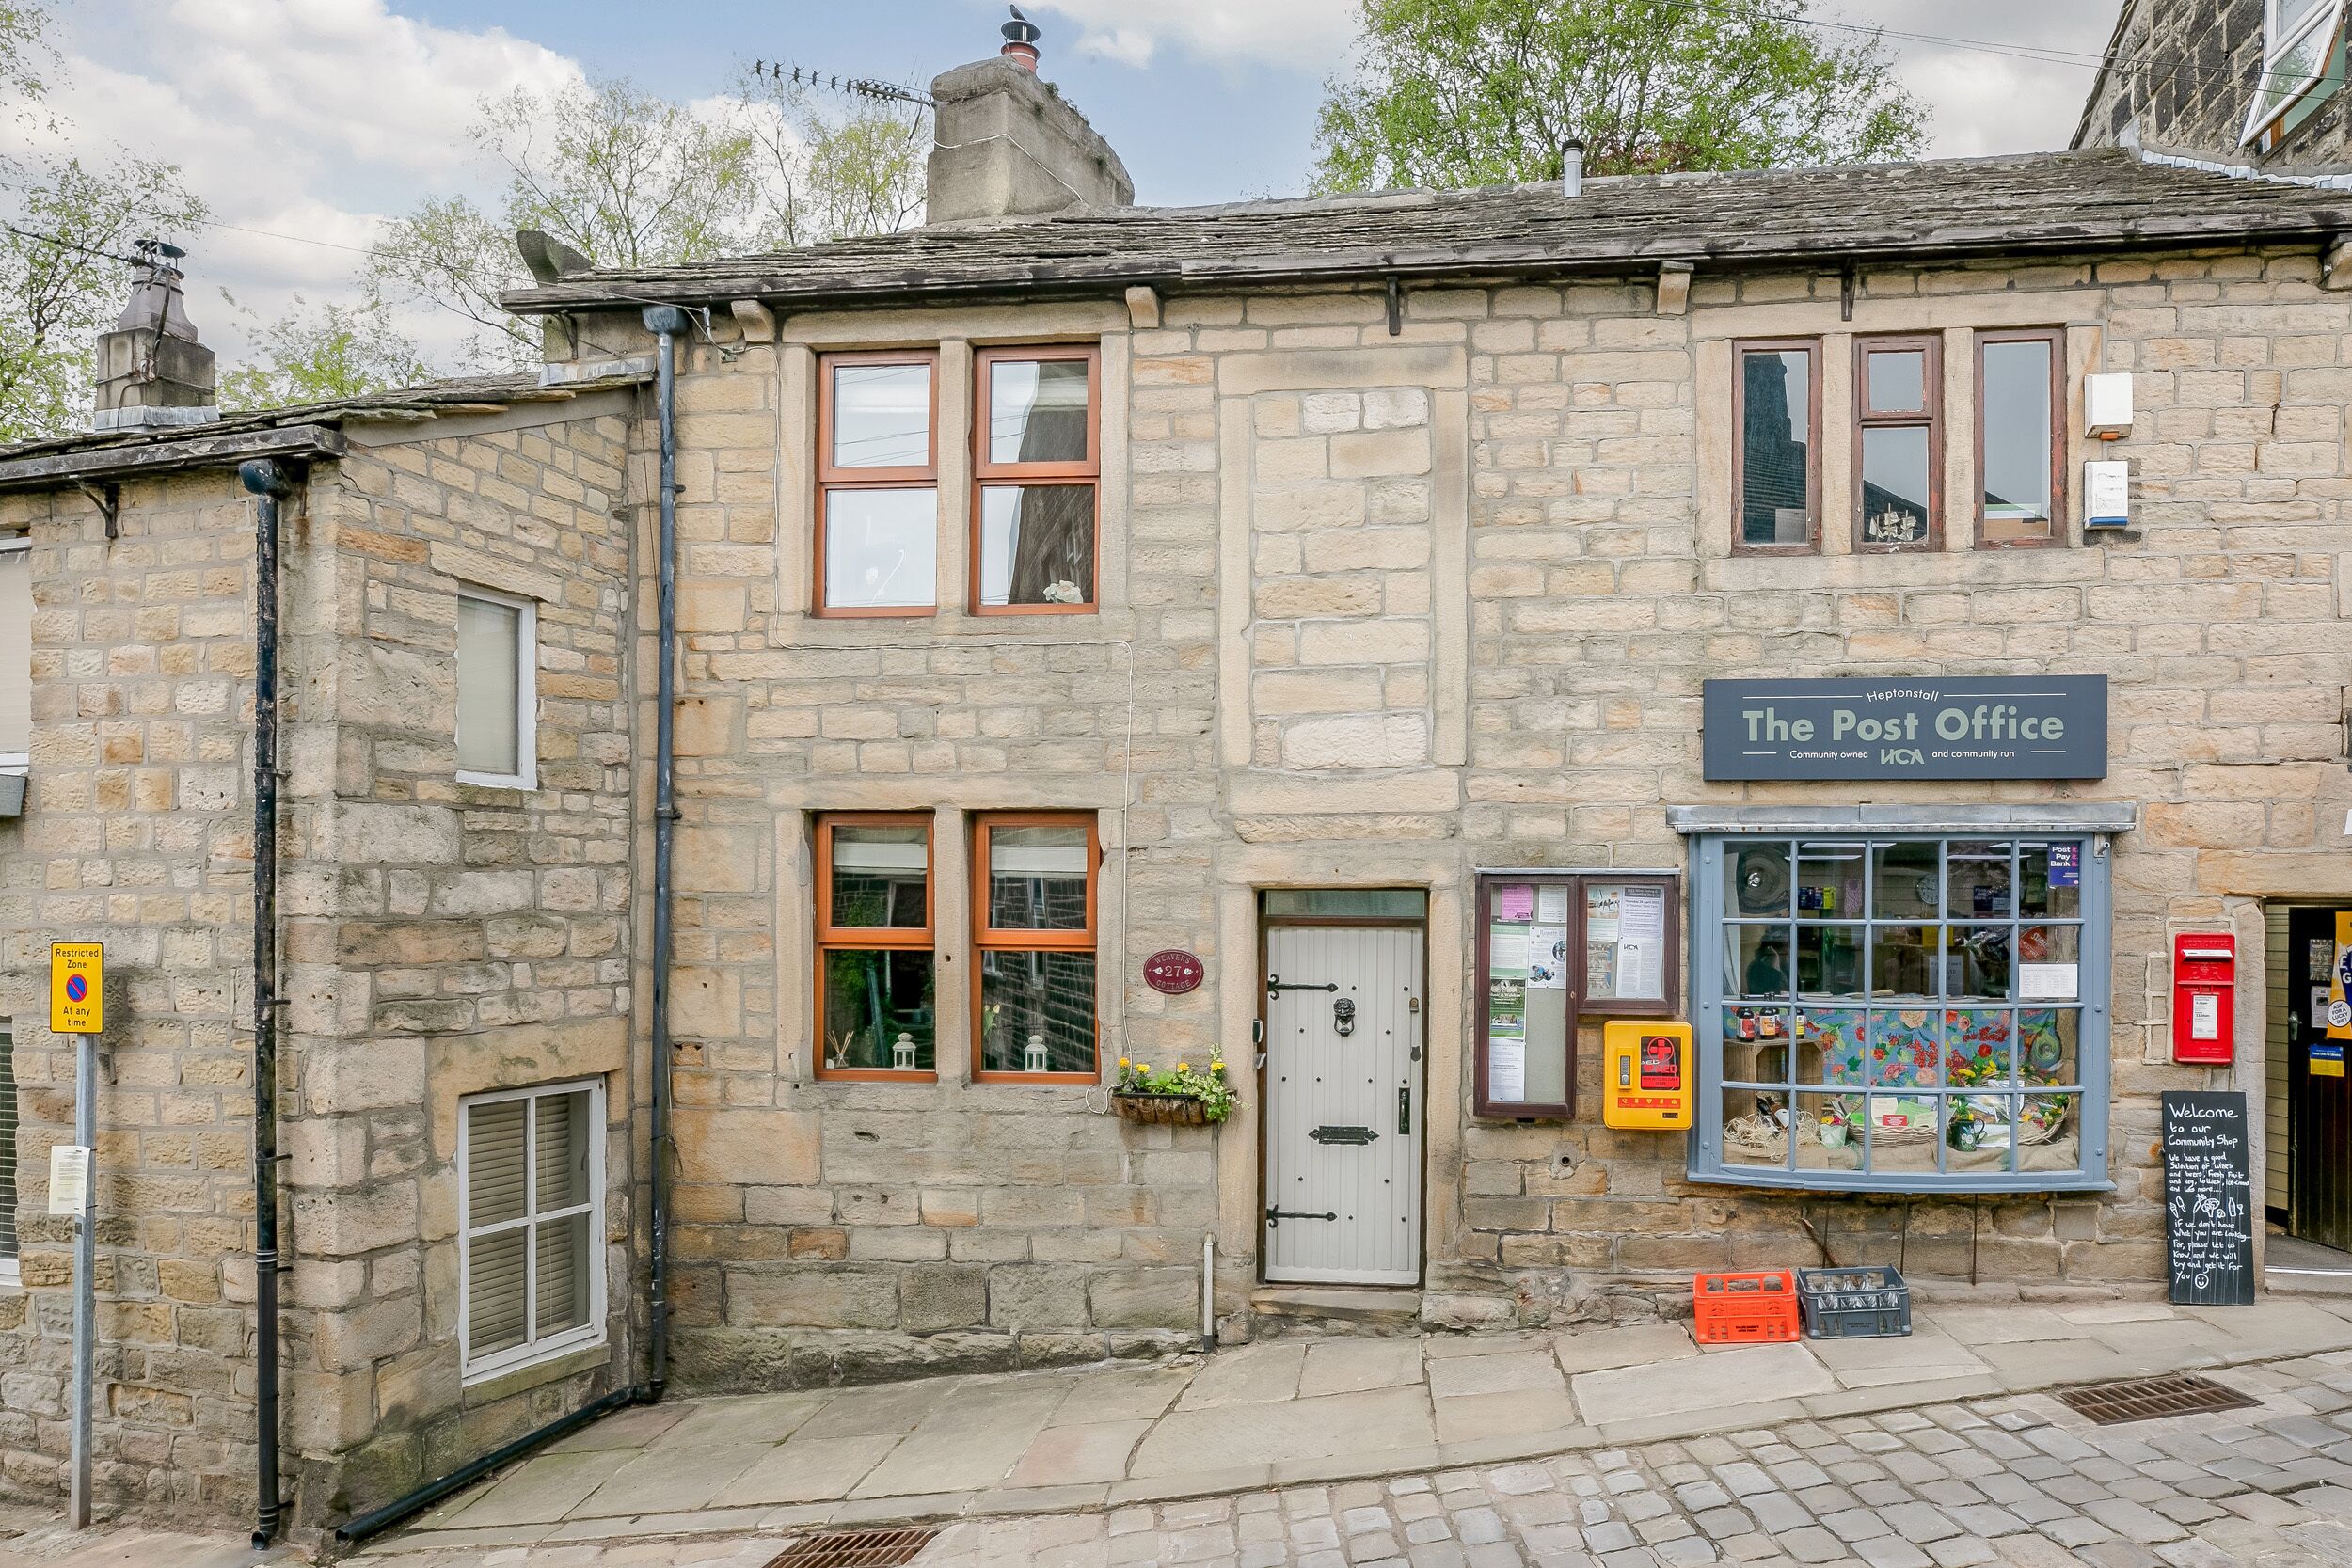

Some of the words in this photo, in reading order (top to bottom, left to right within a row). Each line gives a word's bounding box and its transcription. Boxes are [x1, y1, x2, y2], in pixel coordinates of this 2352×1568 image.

[1867, 689, 1939, 703] Heptonstall
[1742, 707, 1814, 741] The
[1833, 709, 1919, 741] Post
[1935, 705, 2064, 741] Office
[1789, 750, 1837, 760] Community
[1840, 750, 1868, 759] owned
[1931, 750, 1948, 758] and
[1951, 750, 1997, 760] community
[56, 948, 99, 958] Restricted
[67, 959, 87, 969] Zone
[1155, 954, 1190, 964] WEAVERS
[1165, 965, 1182, 977] 27
[1156, 979, 1192, 990] COTTAGE
[63, 1006, 73, 1015] At
[75, 1008, 90, 1017] any
[2331, 1011, 2348, 1021] LUCKY
[67, 1017, 87, 1026] time
[2169, 1102, 2238, 1118] Welcome
[2169, 1121, 2185, 1132] to
[2191, 1125, 2211, 1133] our
[2168, 1134, 2215, 1149] Community
[2217, 1133, 2238, 1148] Shop
[2169, 1153, 2180, 1162] We
[2184, 1153, 2201, 1162] have
[2210, 1151, 2227, 1165] good
[2217, 1220, 2235, 1228] have
[2194, 1230, 2207, 1241] you
[2187, 1242, 2208, 1252] please
[2222, 1252, 2237, 1260] will
[2172, 1259, 2185, 1270] try
[2203, 1261, 2217, 1274] get
